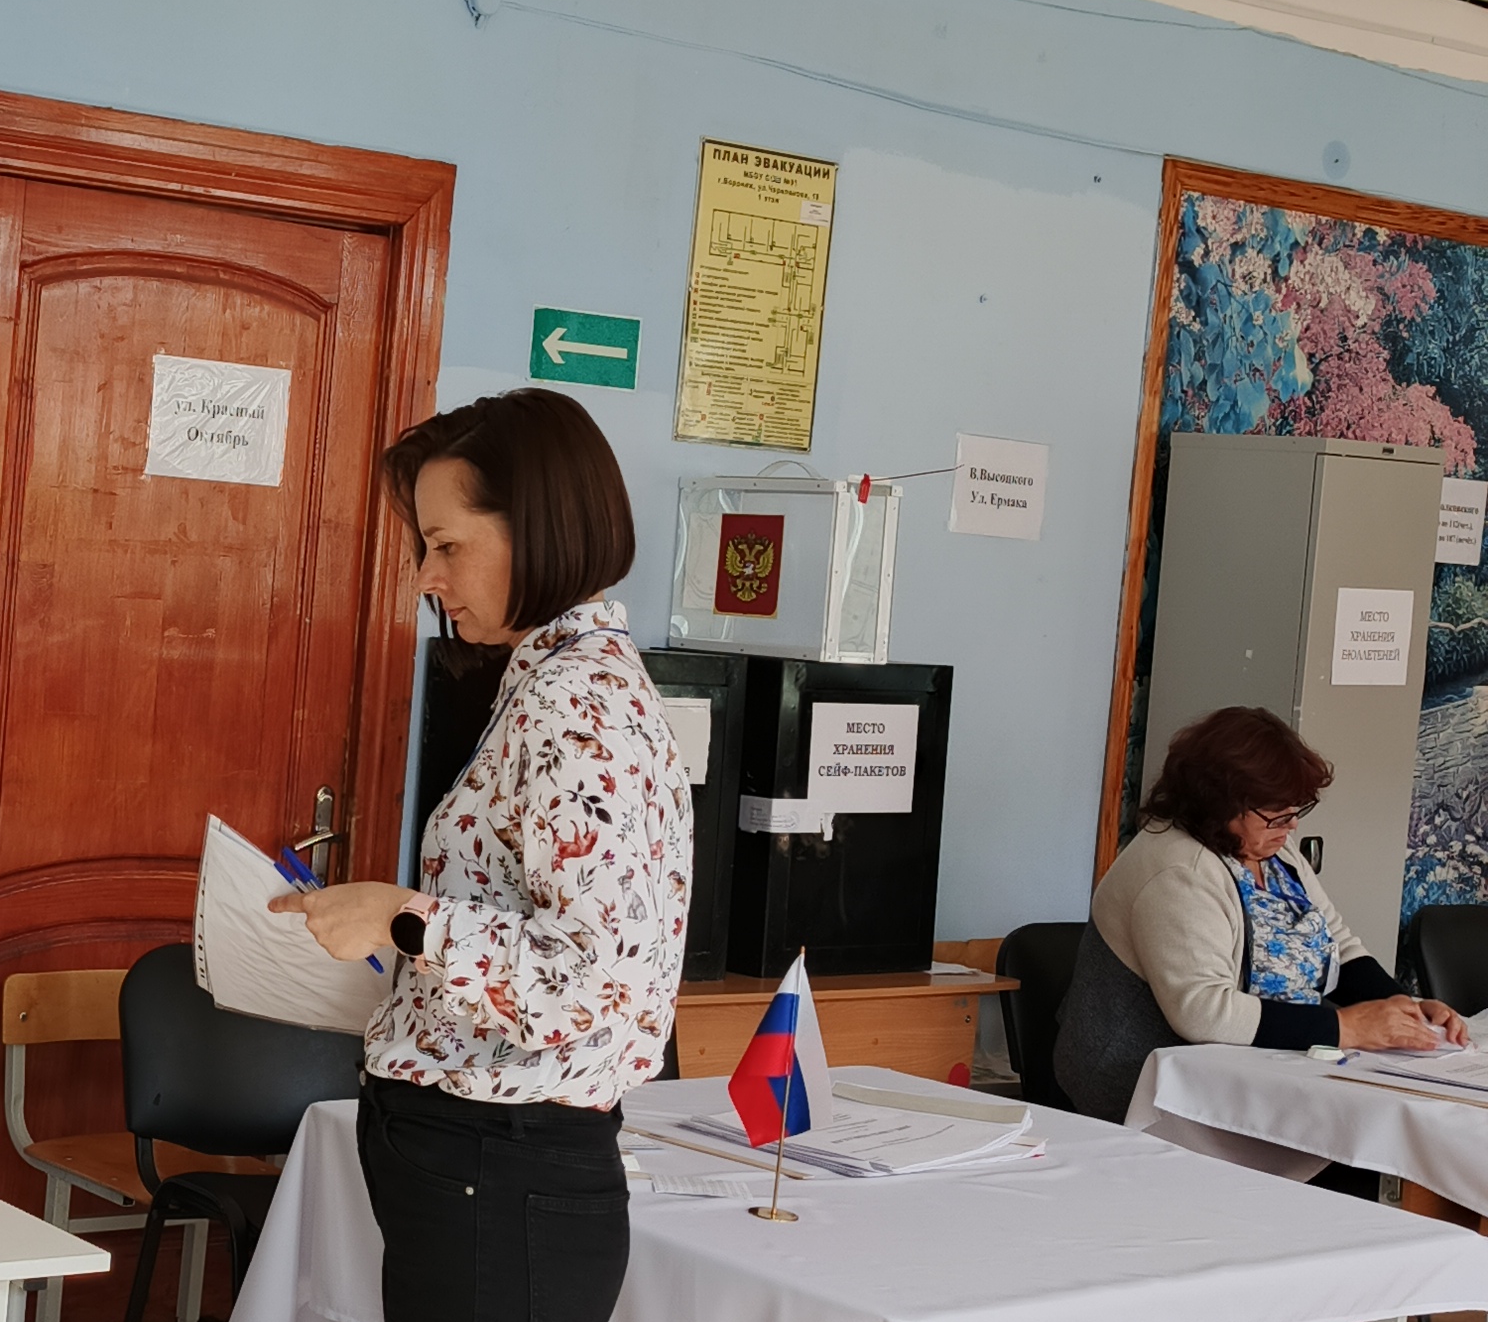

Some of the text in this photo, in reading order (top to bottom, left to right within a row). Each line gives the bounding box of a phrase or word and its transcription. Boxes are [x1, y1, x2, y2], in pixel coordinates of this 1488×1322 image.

[713, 148, 830, 180] ПЛАН ЭВАКУАЦИИ
[174, 400, 196, 415] ул.
[187, 427, 250, 449] Октябрь
[970, 490, 1027, 509] Ул. Ермака
[1359, 611, 1389, 622] МЕСТО
[1349, 630, 1395, 643] ХРАНЕНИЯ
[1341, 648, 1400, 661] БЮЛЛЕТЕНЕЙ
[846, 722, 885, 734] МЕСТО
[832, 744, 895, 756] ХРАНЕНИЯ
[818, 762, 907, 777] СЕЙФ-ПАКЕТОВ
